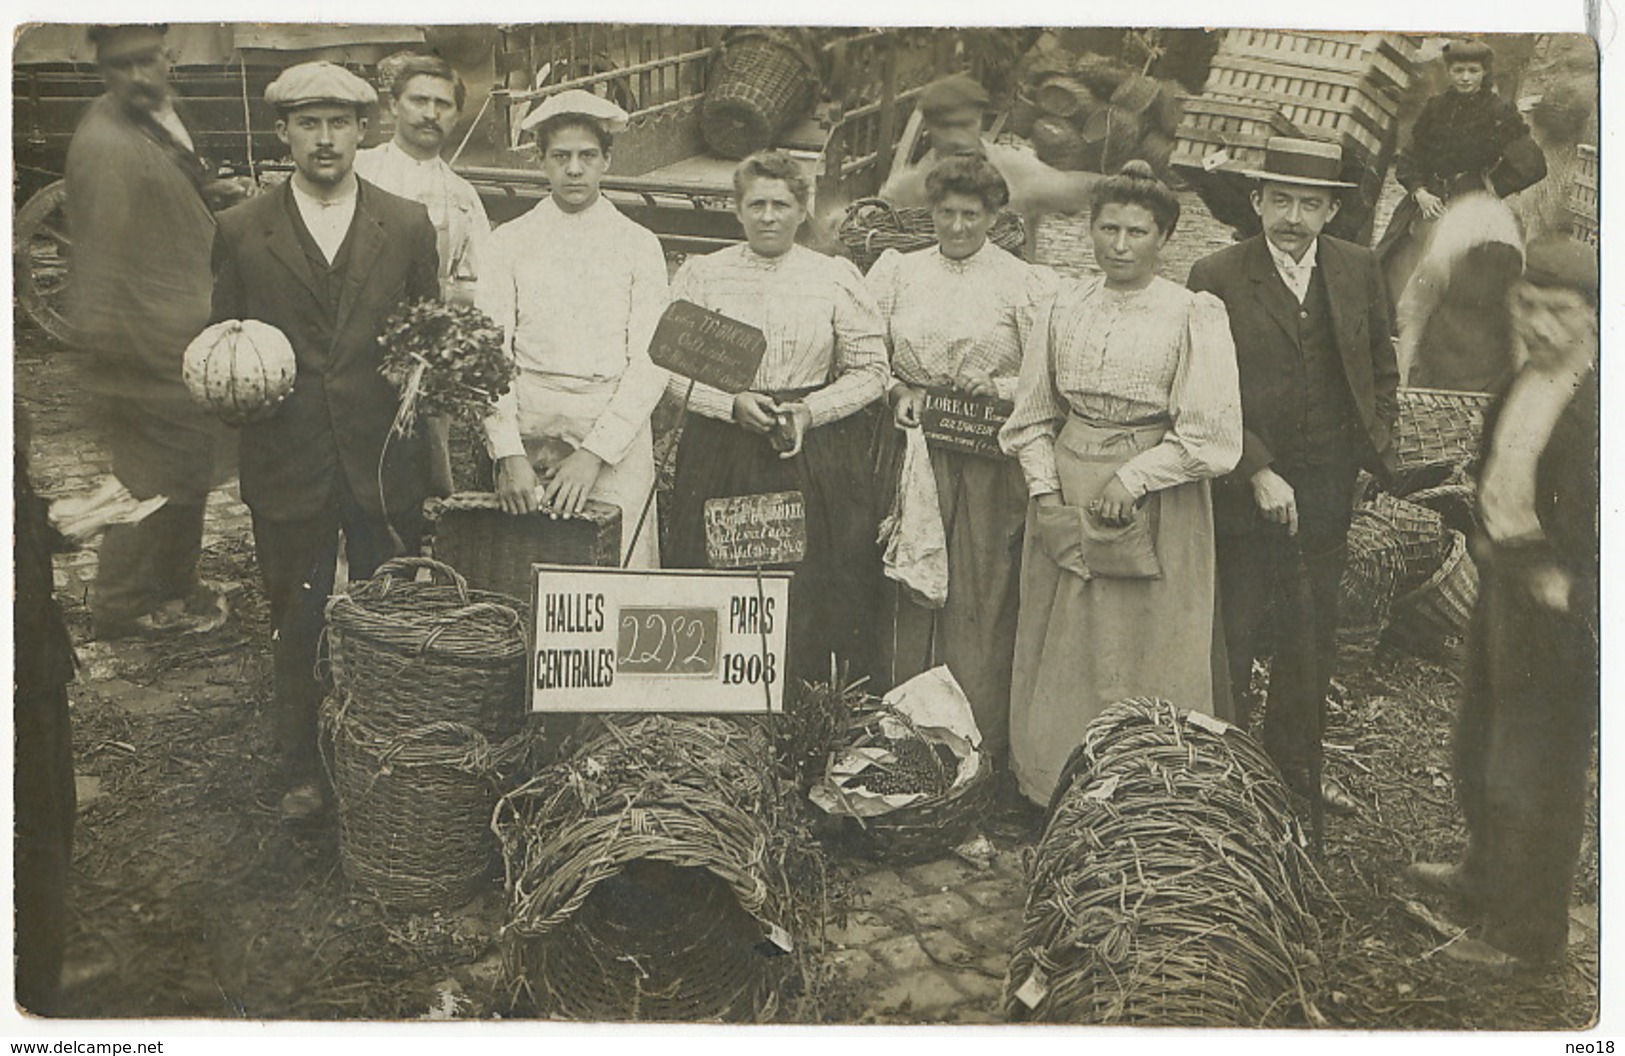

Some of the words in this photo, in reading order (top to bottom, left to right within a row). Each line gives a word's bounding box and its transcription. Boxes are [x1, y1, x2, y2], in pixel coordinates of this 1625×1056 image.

[545, 593, 605, 633] HALLES
[729, 596, 775, 635] PARIS
[536, 648, 614, 690] CENTRALES
[722, 652, 776, 685] 1908
